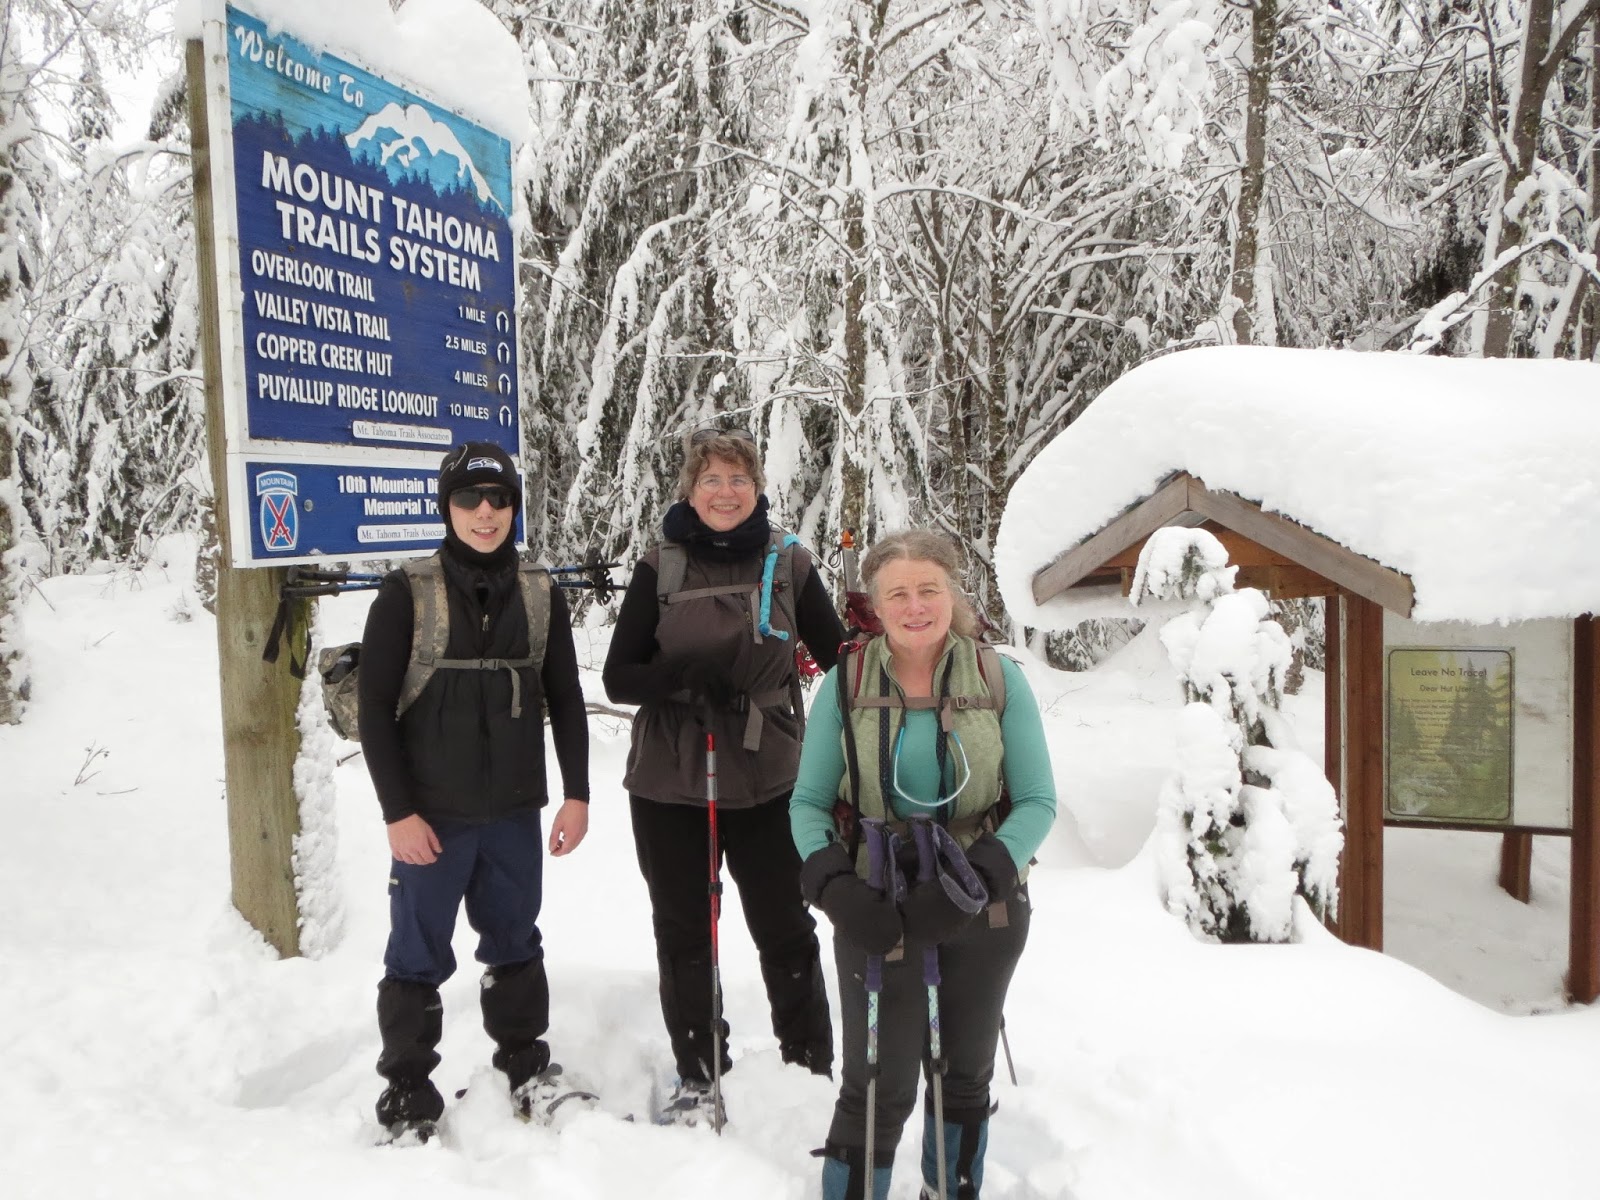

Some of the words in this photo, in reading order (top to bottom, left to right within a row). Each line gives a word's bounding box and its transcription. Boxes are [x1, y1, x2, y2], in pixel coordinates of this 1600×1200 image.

[235, 25, 331, 94] Welcome
[339, 73, 364, 108] To
[261, 150, 384, 224] MOUNT
[391, 195, 500, 263] TAHOMA
[276, 200, 381, 264] TRAILS
[389, 235, 482, 292] SYSTEM
[252, 250, 334, 293] OVERLOOK
[337, 270, 375, 302] TRAIL
[254, 290, 309, 326] VALLEY
[311, 303, 352, 334] VISTA
[354, 312, 391, 341] TRAIL
[458, 306, 463, 318] 1
[465, 307, 486, 324] MILE
[445, 335, 459, 350] 2.5
[461, 337, 487, 355] MILES
[256, 332, 317, 366] COPPER
[320, 343, 364, 373] CREEK
[366, 353, 393, 377] HUT
[454, 370, 461, 382] 4
[462, 371, 488, 388] MILES
[258, 373, 334, 406] PUYALLUP
[337, 383, 379, 411] RIDGE
[381, 390, 438, 418] LOOKOUT
[449, 403, 462, 417] 10
[463, 404, 490, 420] MILES
[357, 424, 369, 436] Mt.
[371, 425, 397, 437] Tahoma
[398, 427, 415, 439] Trails
[417, 429, 450, 441] Association
[260, 477, 295, 489] MOUNTAIN
[337, 475, 367, 494] 10th
[370, 475, 425, 494] Mountain
[364, 498, 422, 516] Memorial
[361, 529, 374, 540] Mt.
[376, 529, 401, 539] Tahoma
[402, 528, 420, 538] Trails
[1410, 667, 1438, 677] Leave
[1441, 668, 1456, 677] No
[1420, 684, 1438, 692] Dear
